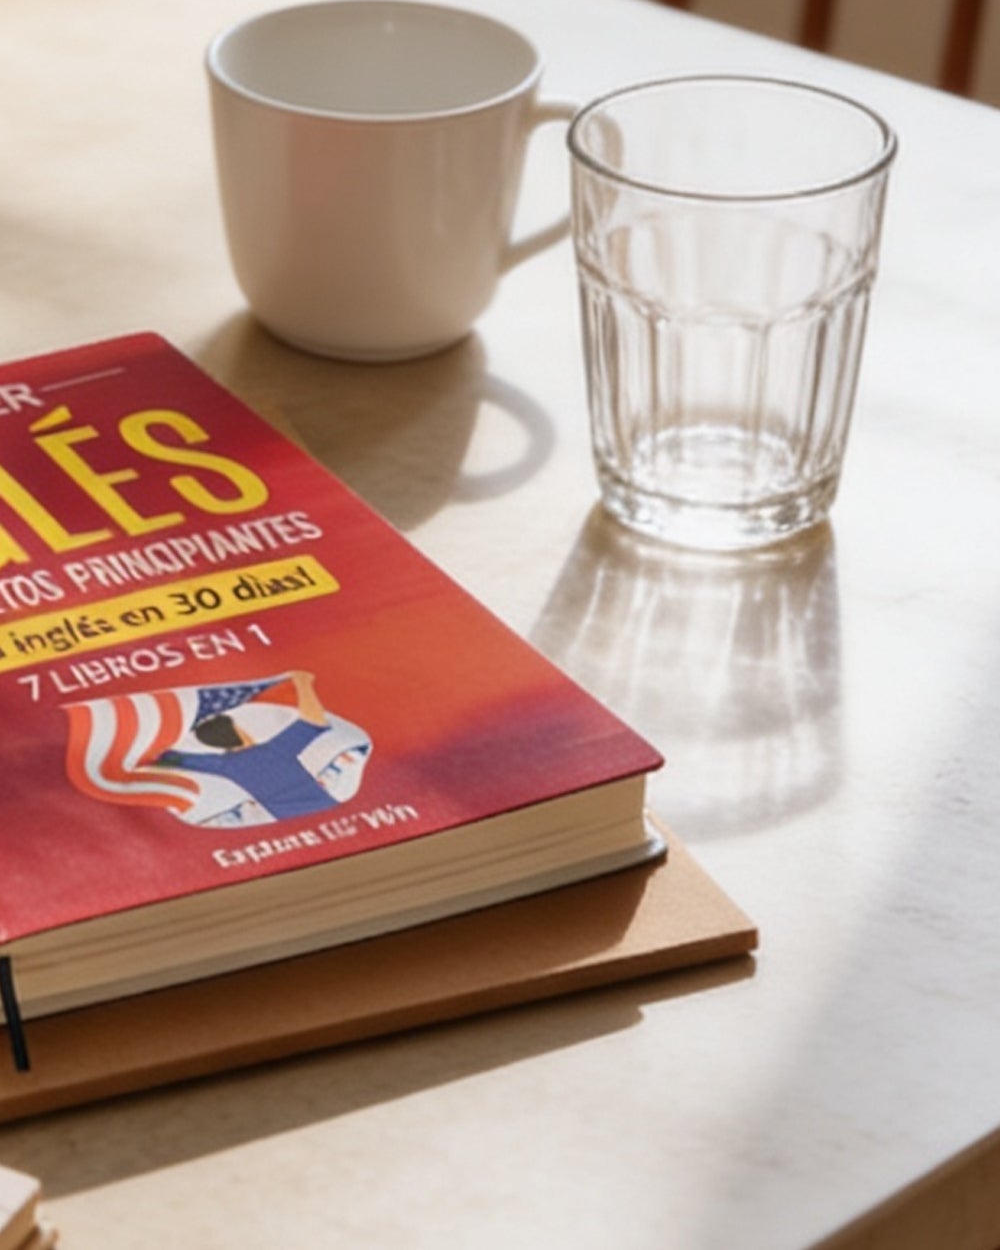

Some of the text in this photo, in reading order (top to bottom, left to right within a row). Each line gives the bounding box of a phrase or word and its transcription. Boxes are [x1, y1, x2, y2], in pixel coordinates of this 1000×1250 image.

[119, 606, 166, 627] en
[168, 588, 222, 615] 30
[17, 623, 272, 702] 7 LIBROS EN 1
